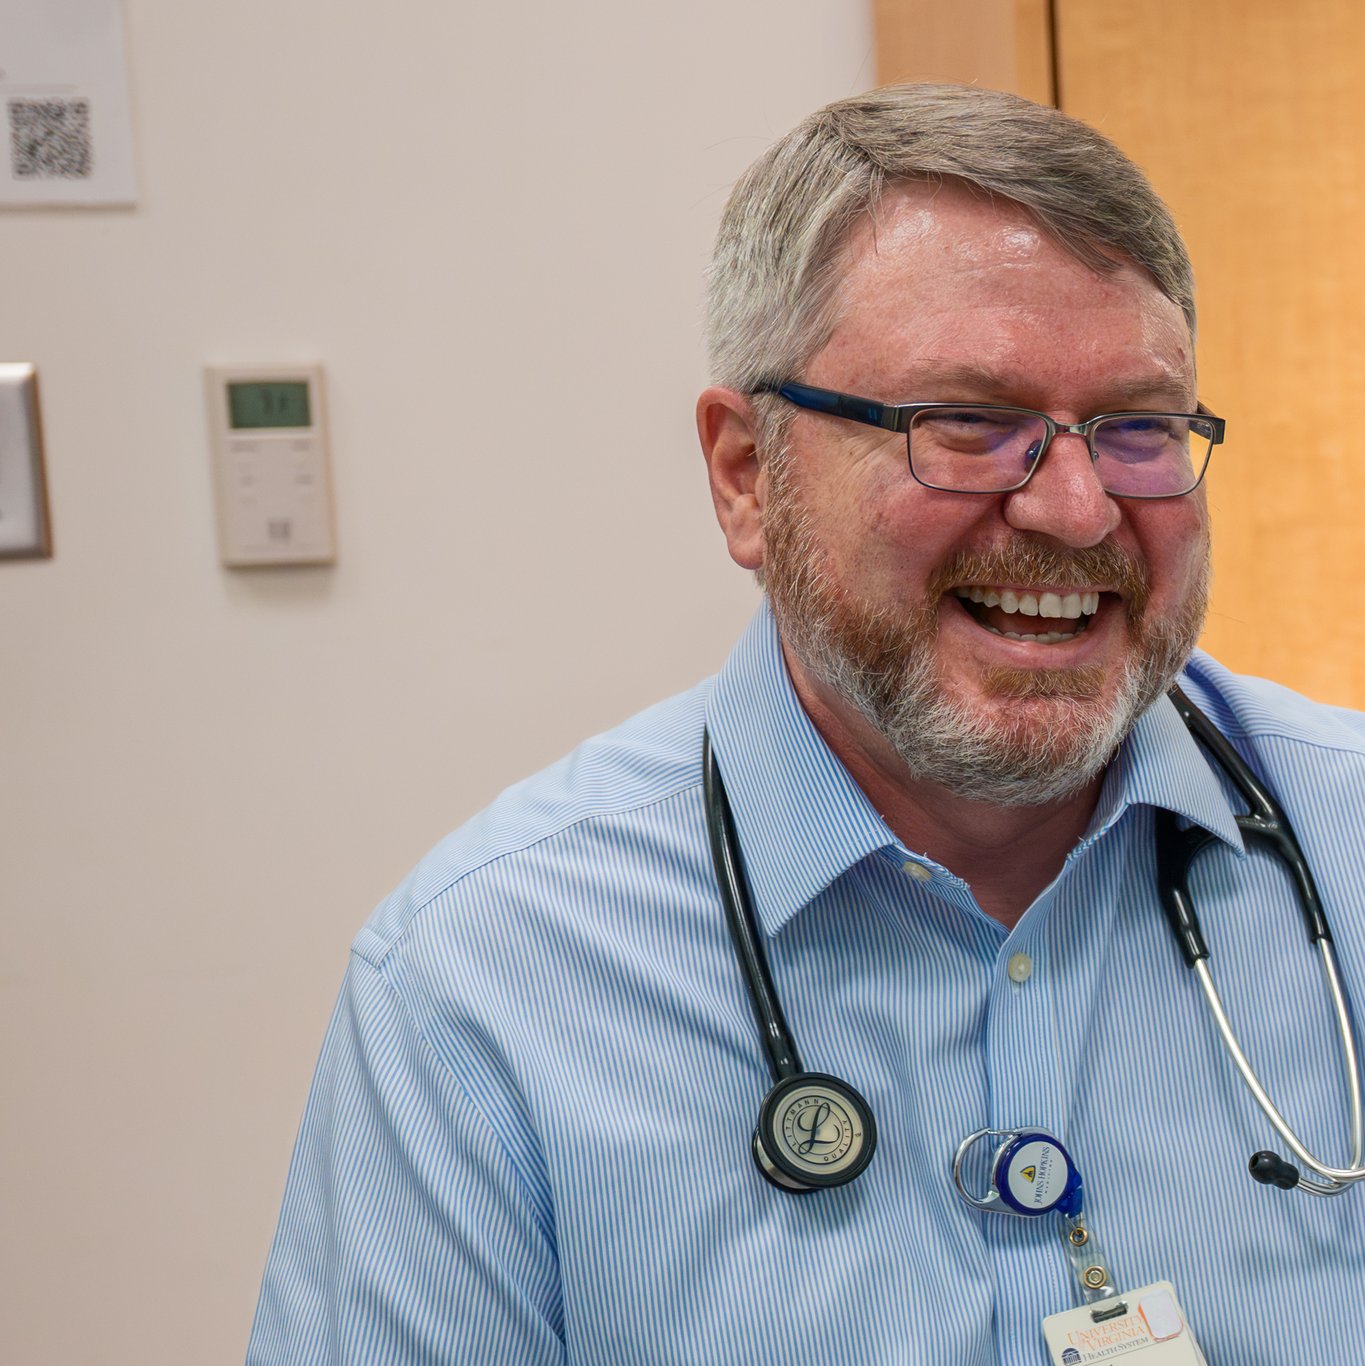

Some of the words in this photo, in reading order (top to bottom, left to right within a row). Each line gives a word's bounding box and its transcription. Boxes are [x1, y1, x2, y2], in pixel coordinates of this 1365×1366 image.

[786, 1098, 819, 1147] LITTMANN
[823, 1119, 850, 1162] QUALITY
[1038, 1146, 1050, 1180] HOPKINS
[1034, 1180, 1045, 1205] JOHNS
[1085, 1326, 1146, 1351] VIRGINIA
[1117, 1336, 1149, 1354] SYSTEM
